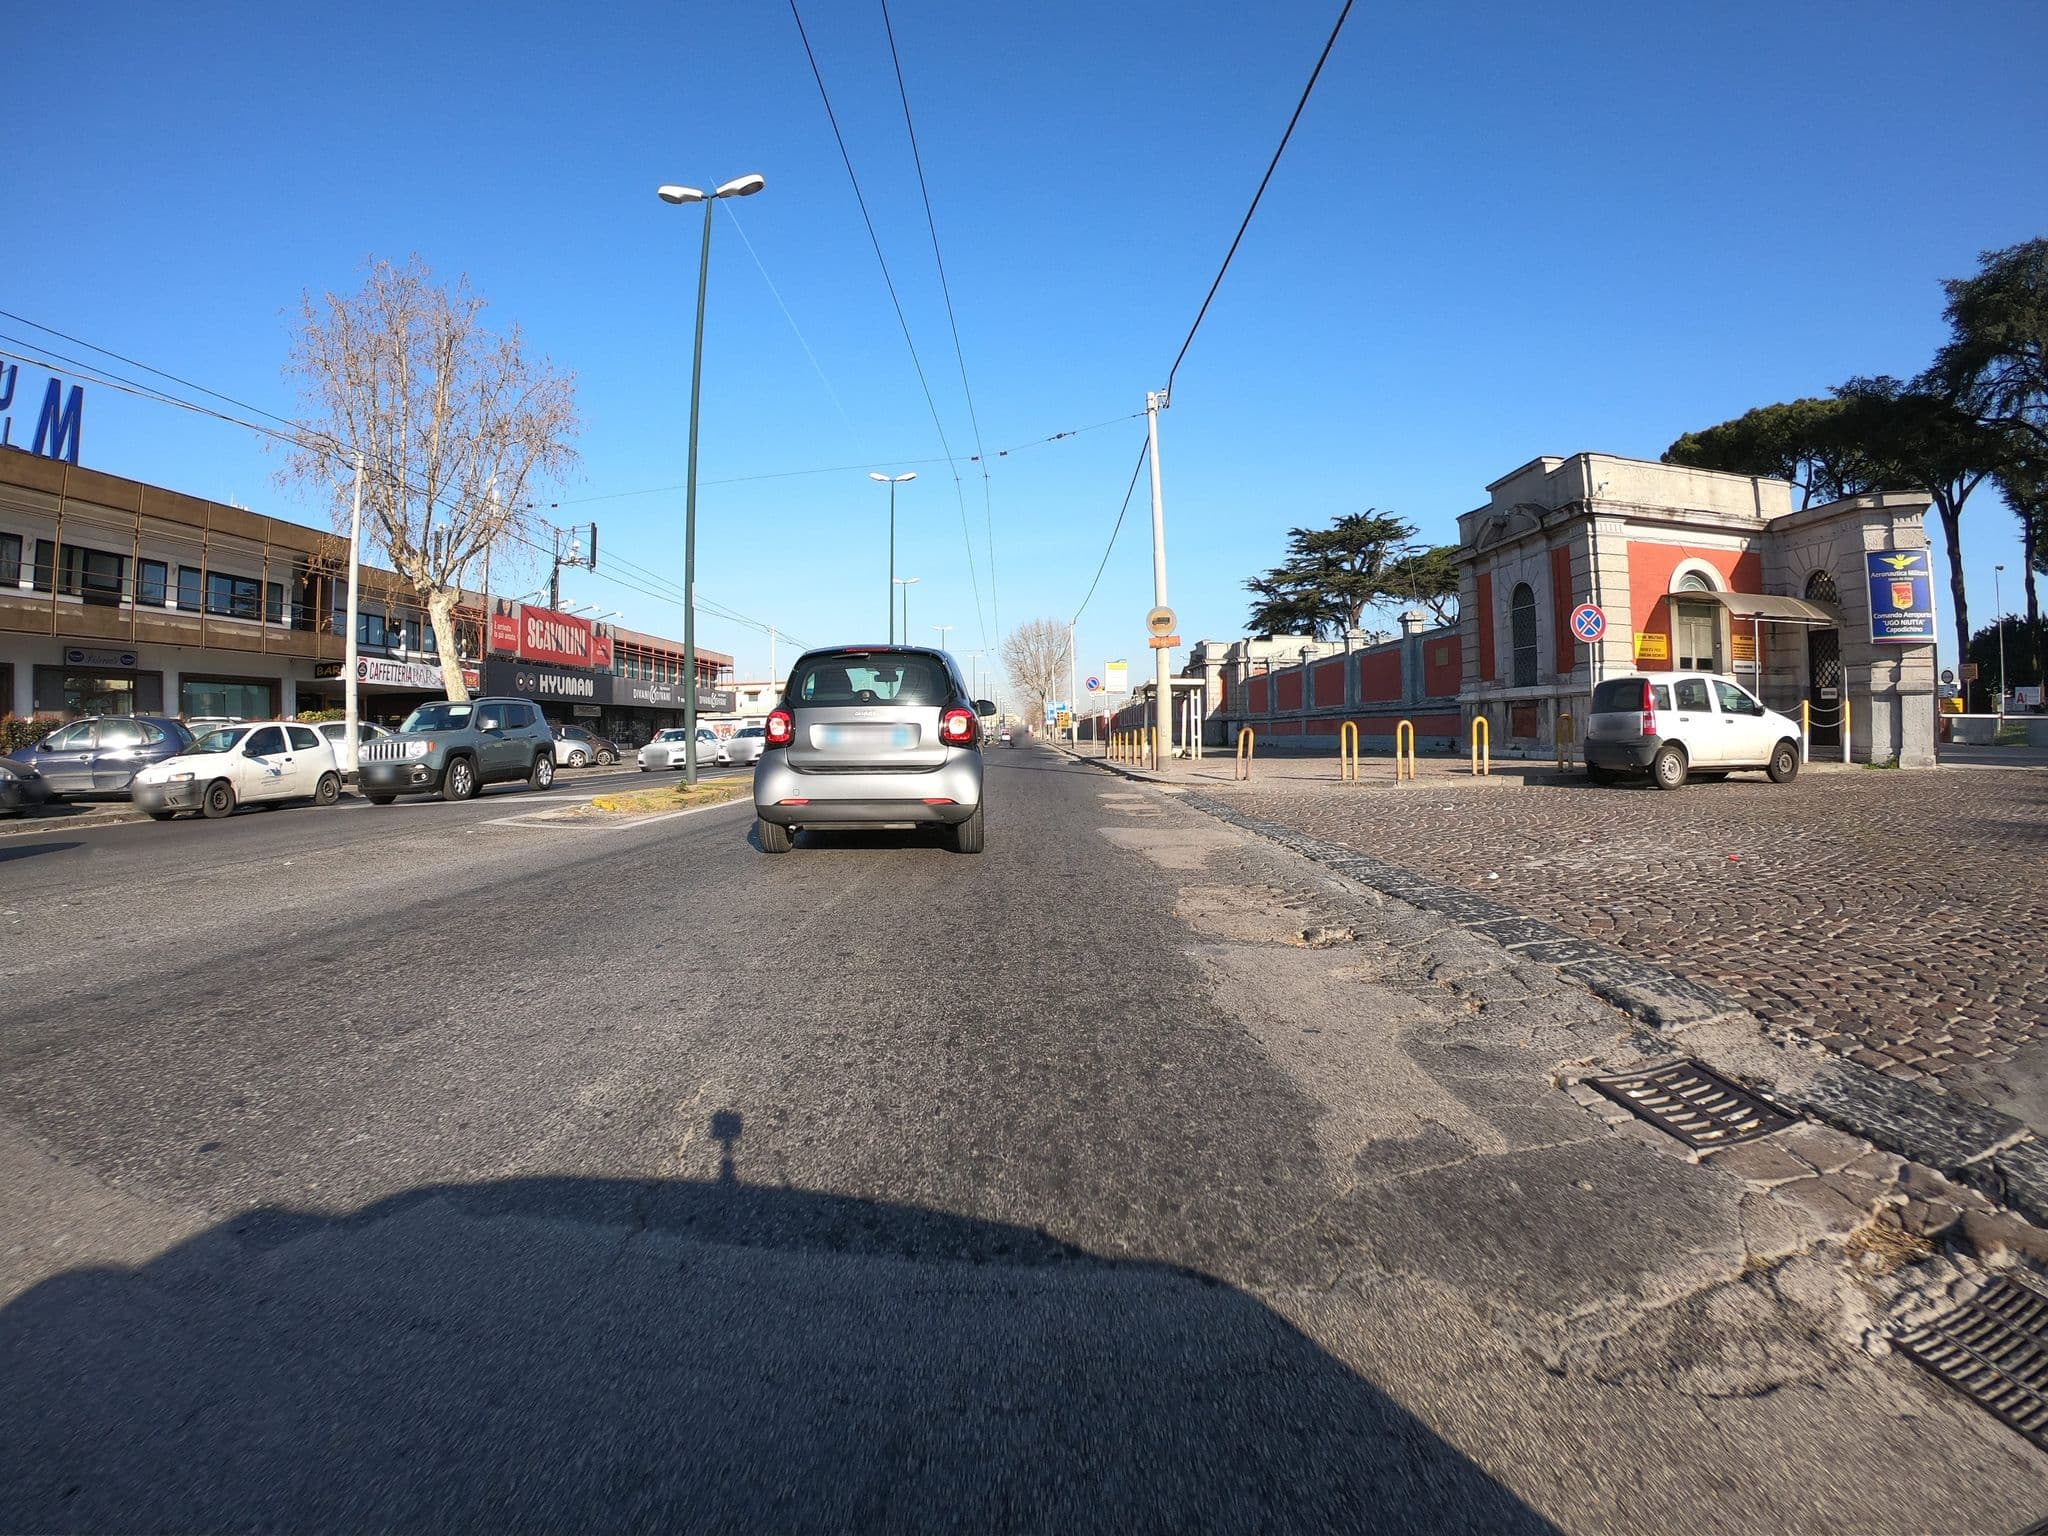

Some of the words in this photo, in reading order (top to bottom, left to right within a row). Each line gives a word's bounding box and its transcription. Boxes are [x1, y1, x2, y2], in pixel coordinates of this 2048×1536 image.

[1871, 570, 1907, 578] Aeronautica
[527, 617, 586, 657] SCAVOLINI
[316, 665, 341, 677] BAR
[369, 661, 412, 683] CAFFETTERIA
[412, 667, 432, 685] BAR
[539, 674, 594, 697] HYUMAN
